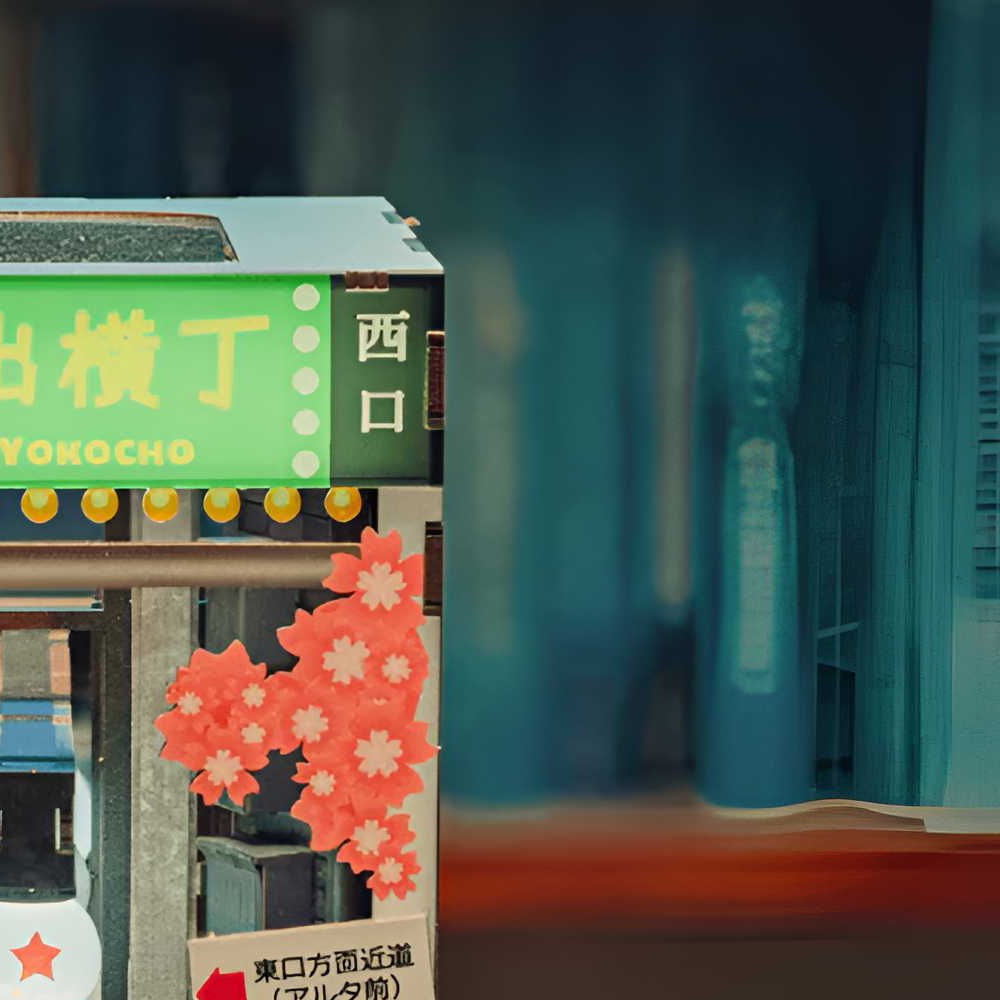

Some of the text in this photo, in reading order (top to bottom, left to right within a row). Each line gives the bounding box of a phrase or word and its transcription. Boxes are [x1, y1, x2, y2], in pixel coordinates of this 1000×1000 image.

[356, 309, 411, 435] 西口
[253, 942, 415, 984] 東口方面近道
